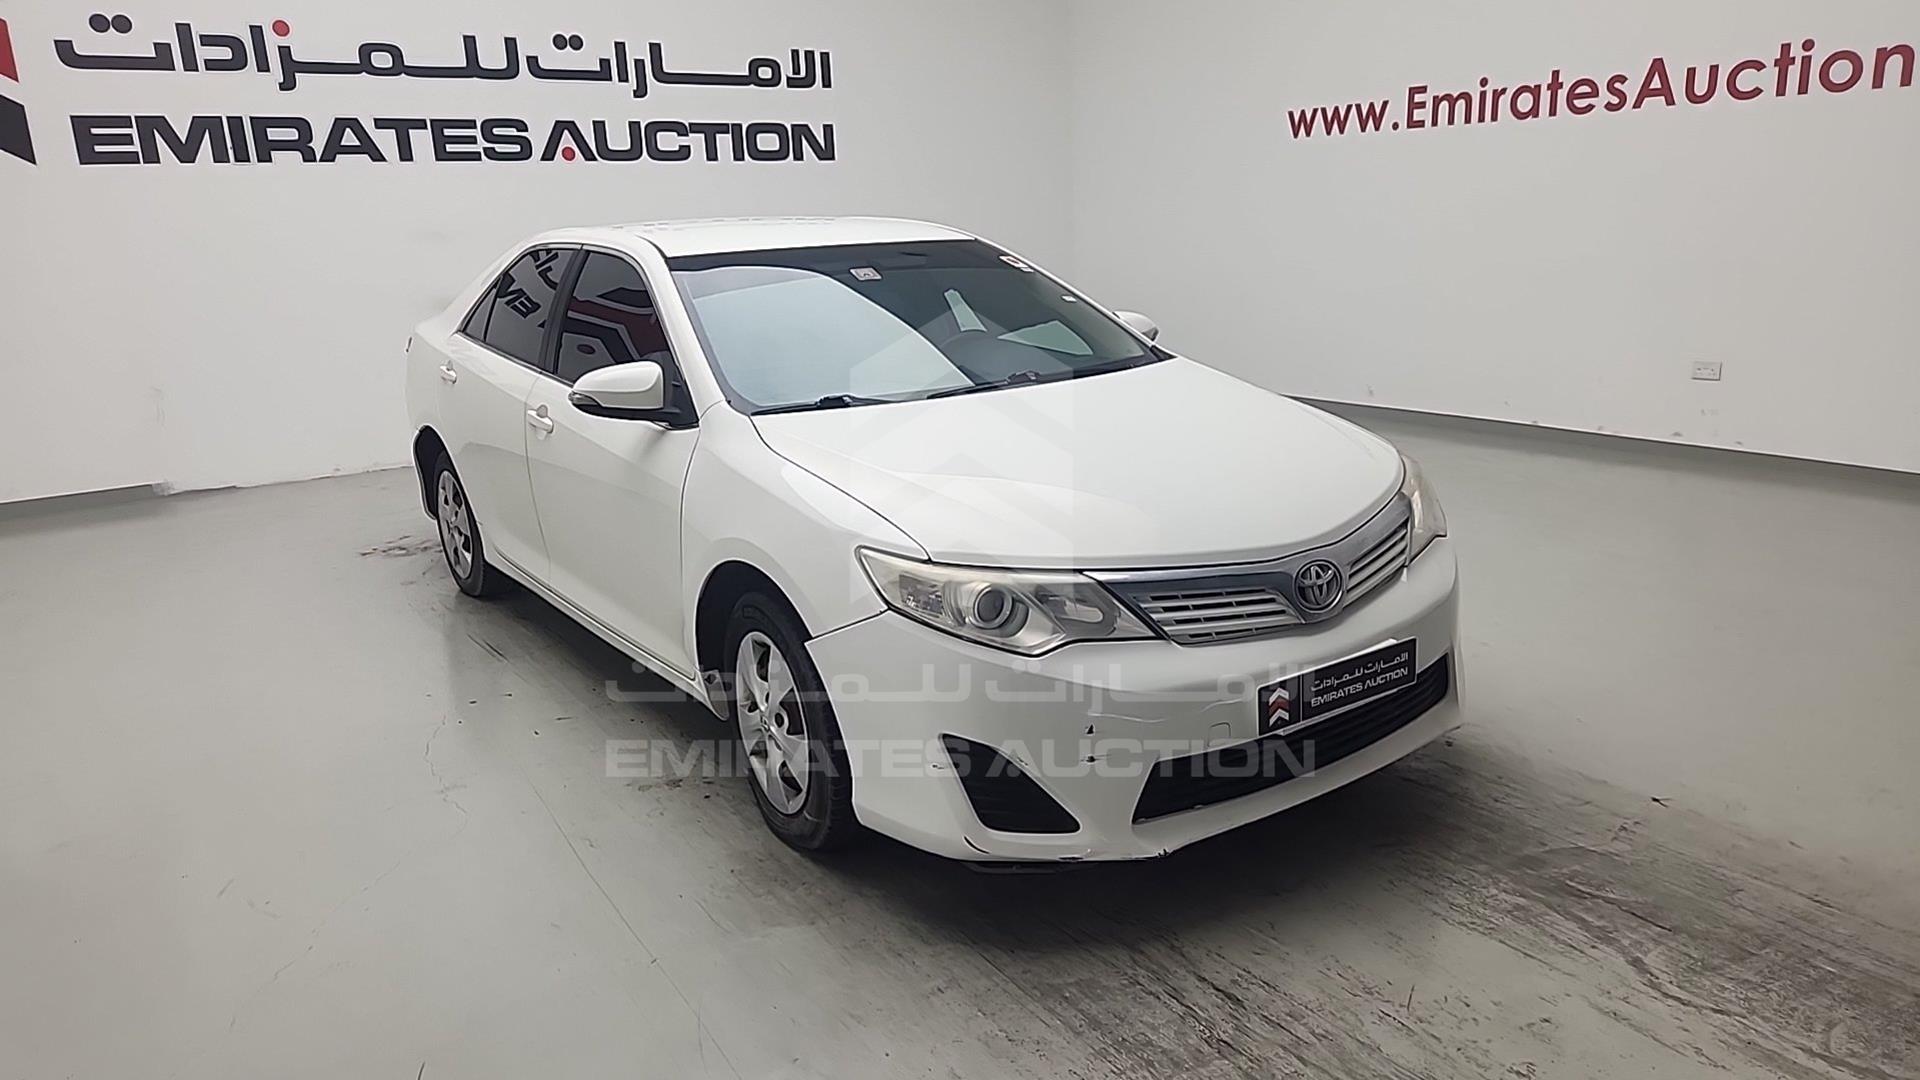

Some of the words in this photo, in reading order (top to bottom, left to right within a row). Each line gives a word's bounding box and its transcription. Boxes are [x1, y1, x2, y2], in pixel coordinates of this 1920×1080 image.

[1287, 38, 1917, 140] www.EmiratesAuction
[69, 115, 531, 166] EMIRATES
[540, 119, 836, 163] AUCTION
[1311, 682, 1363, 708] EMIRATES
[1364, 666, 1409, 690] AUCTION
